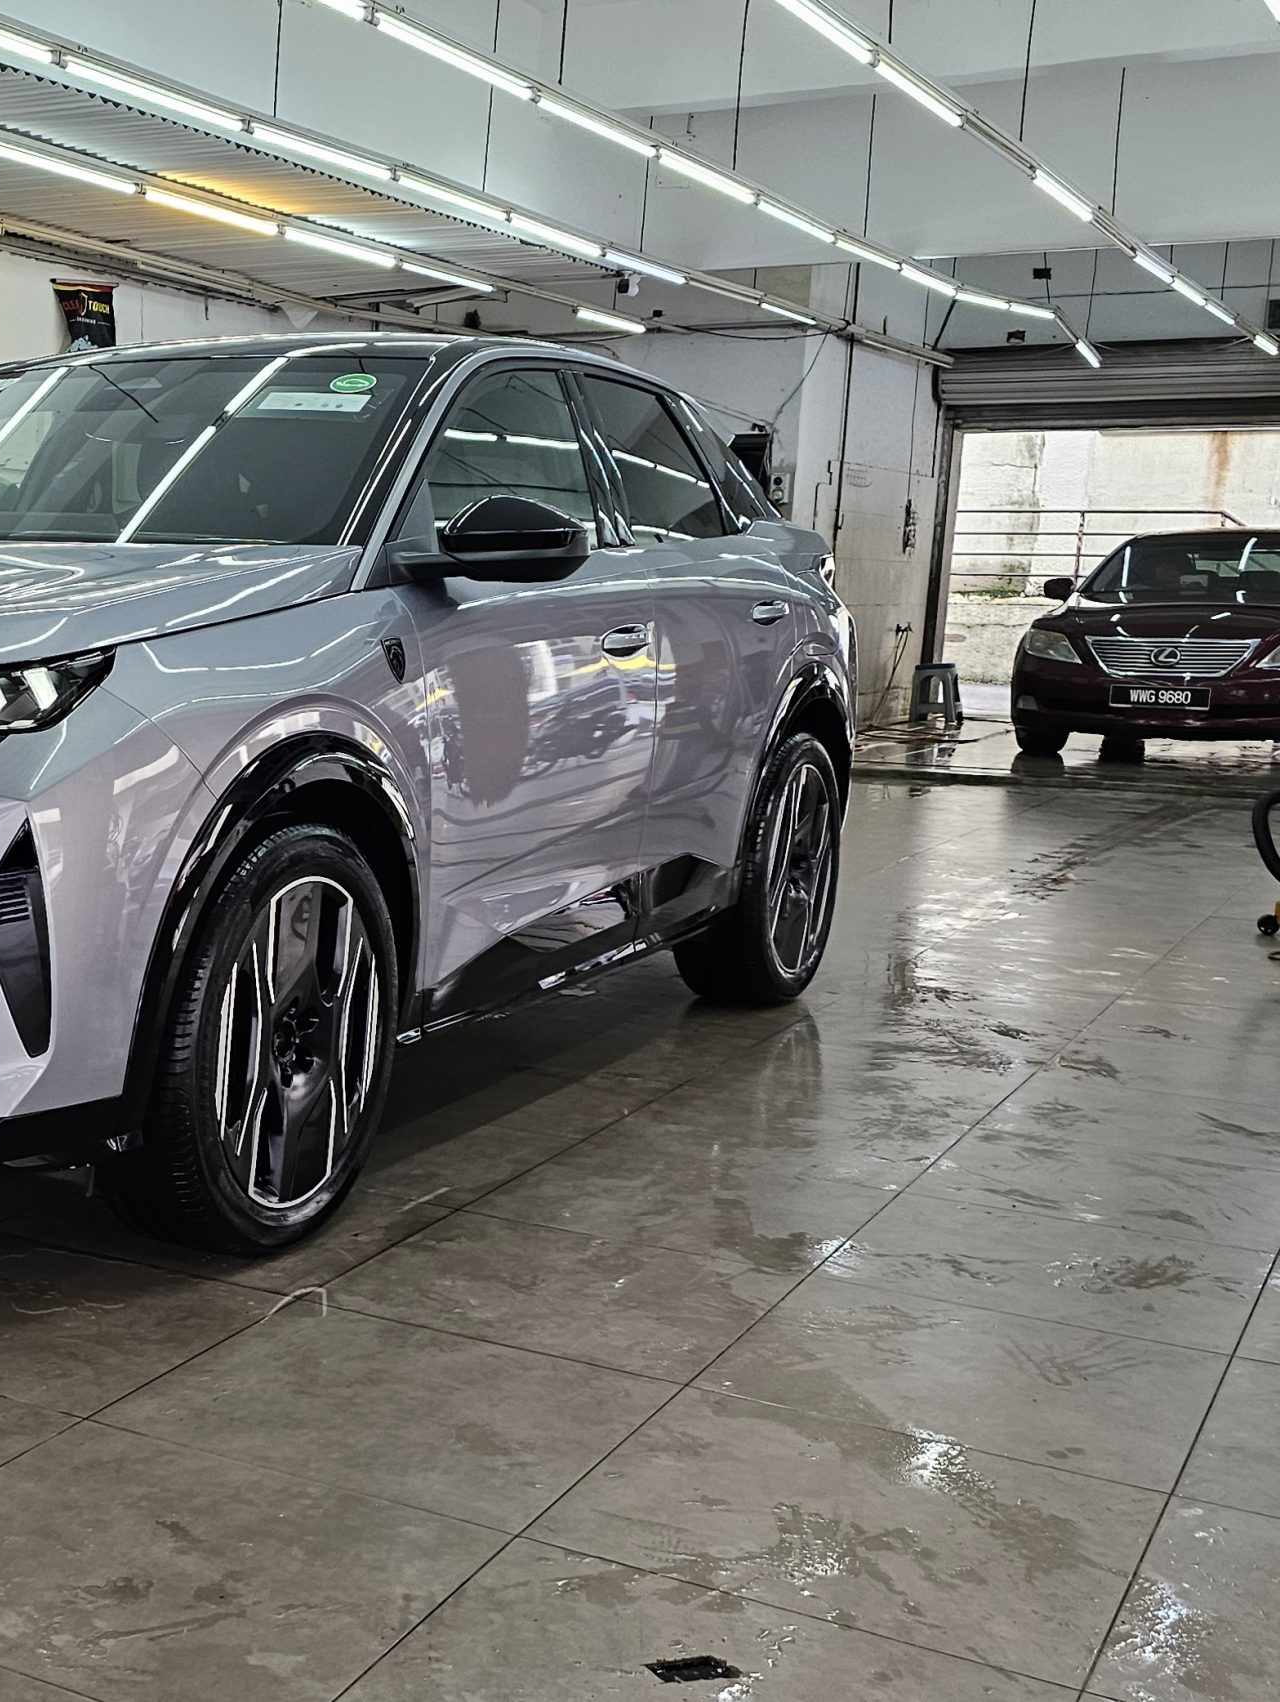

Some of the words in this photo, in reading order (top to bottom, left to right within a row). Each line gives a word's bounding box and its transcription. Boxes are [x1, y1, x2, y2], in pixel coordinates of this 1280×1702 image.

[88, 300, 110, 314] TOUCH
[1130, 689, 1156, 703] WWG
[1158, 690, 1191, 704] 9680
